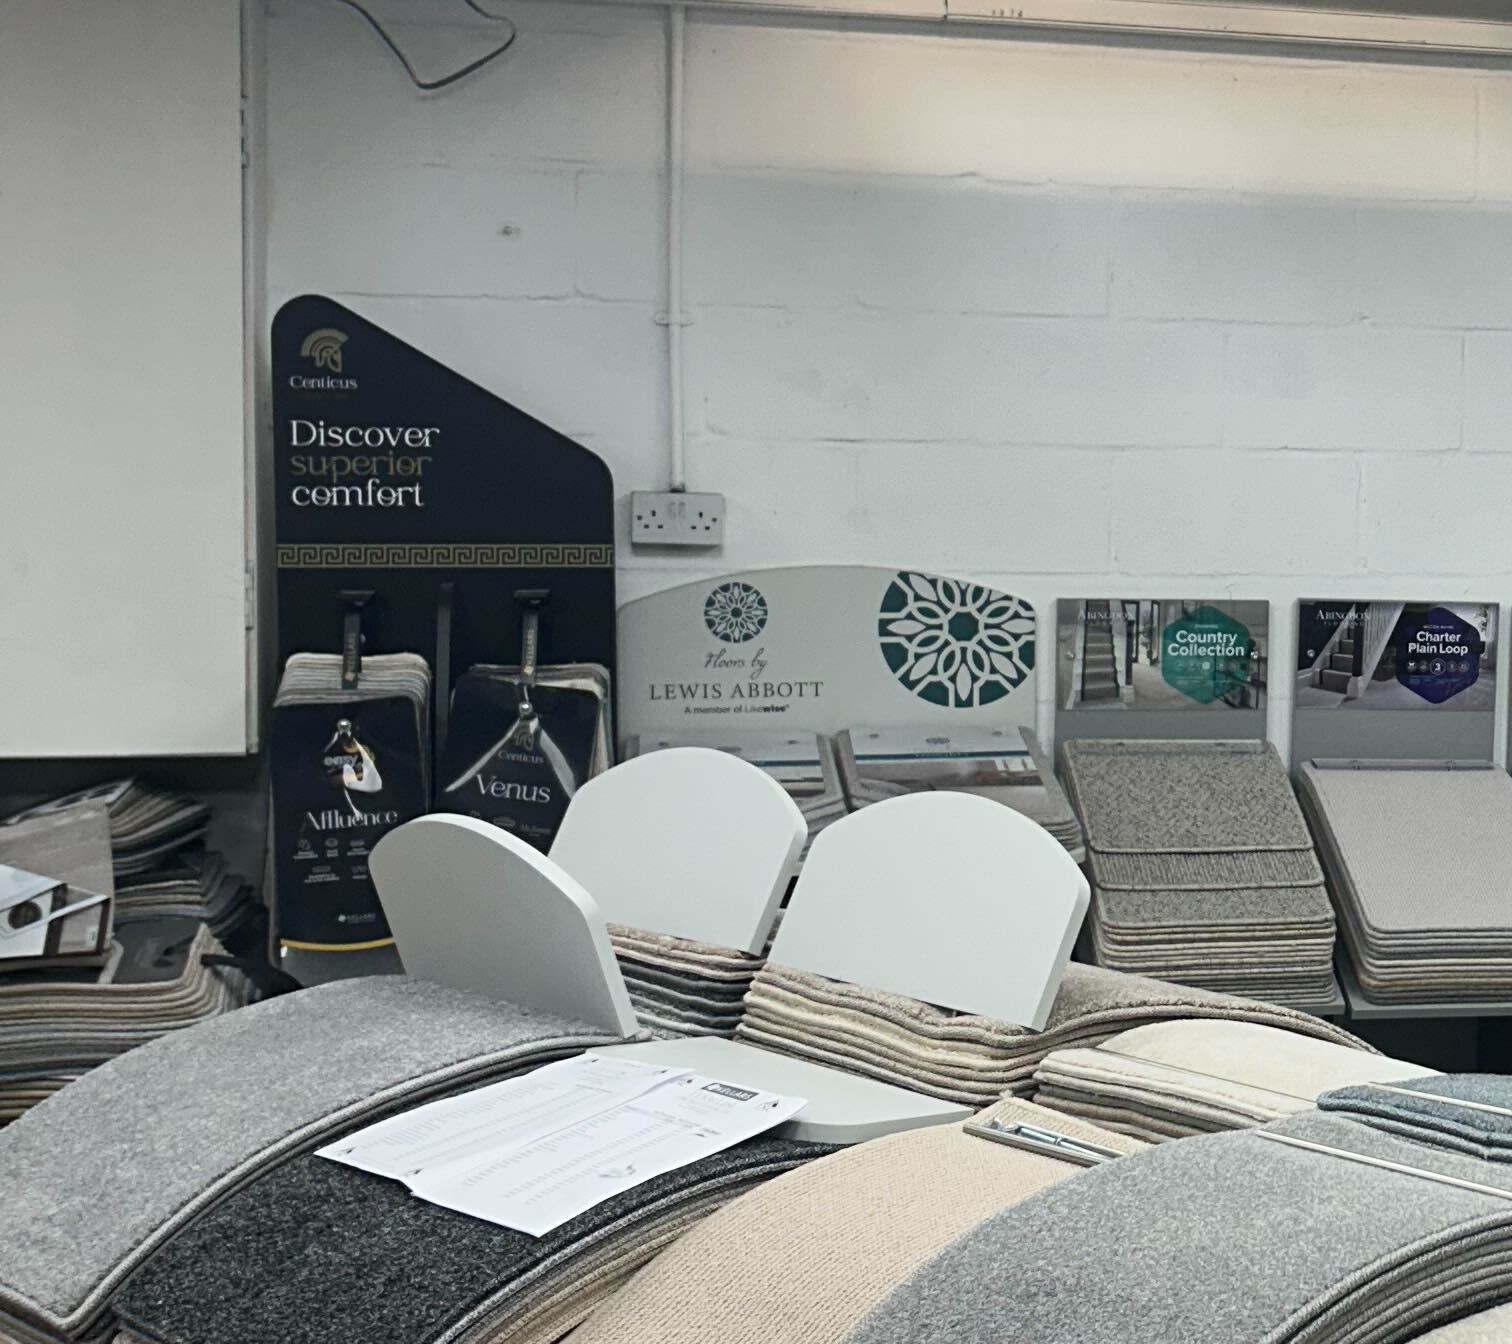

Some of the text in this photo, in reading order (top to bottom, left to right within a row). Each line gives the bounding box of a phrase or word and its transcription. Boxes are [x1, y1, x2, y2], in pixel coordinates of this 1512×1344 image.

[290, 375, 358, 390] Centicus
[290, 419, 440, 448] Discover
[290, 450, 432, 483] superior
[292, 478, 424, 507] comfort
[1316, 608, 1370, 621] ABINGDON
[1175, 630, 1238, 646] Country
[1416, 630, 1461, 643] Charter
[1167, 643, 1245, 657] Collection
[1408, 642, 1469, 656] Plain Loop
[704, 647, 769, 681] Floors by
[649, 681, 824, 701] LEWIS ABBOTT
[684, 706, 692, 714] A
[693, 706, 731, 714] member
[733, 705, 743, 713] of
[476, 774, 551, 803] Venus
[303, 809, 399, 832] Affluence
